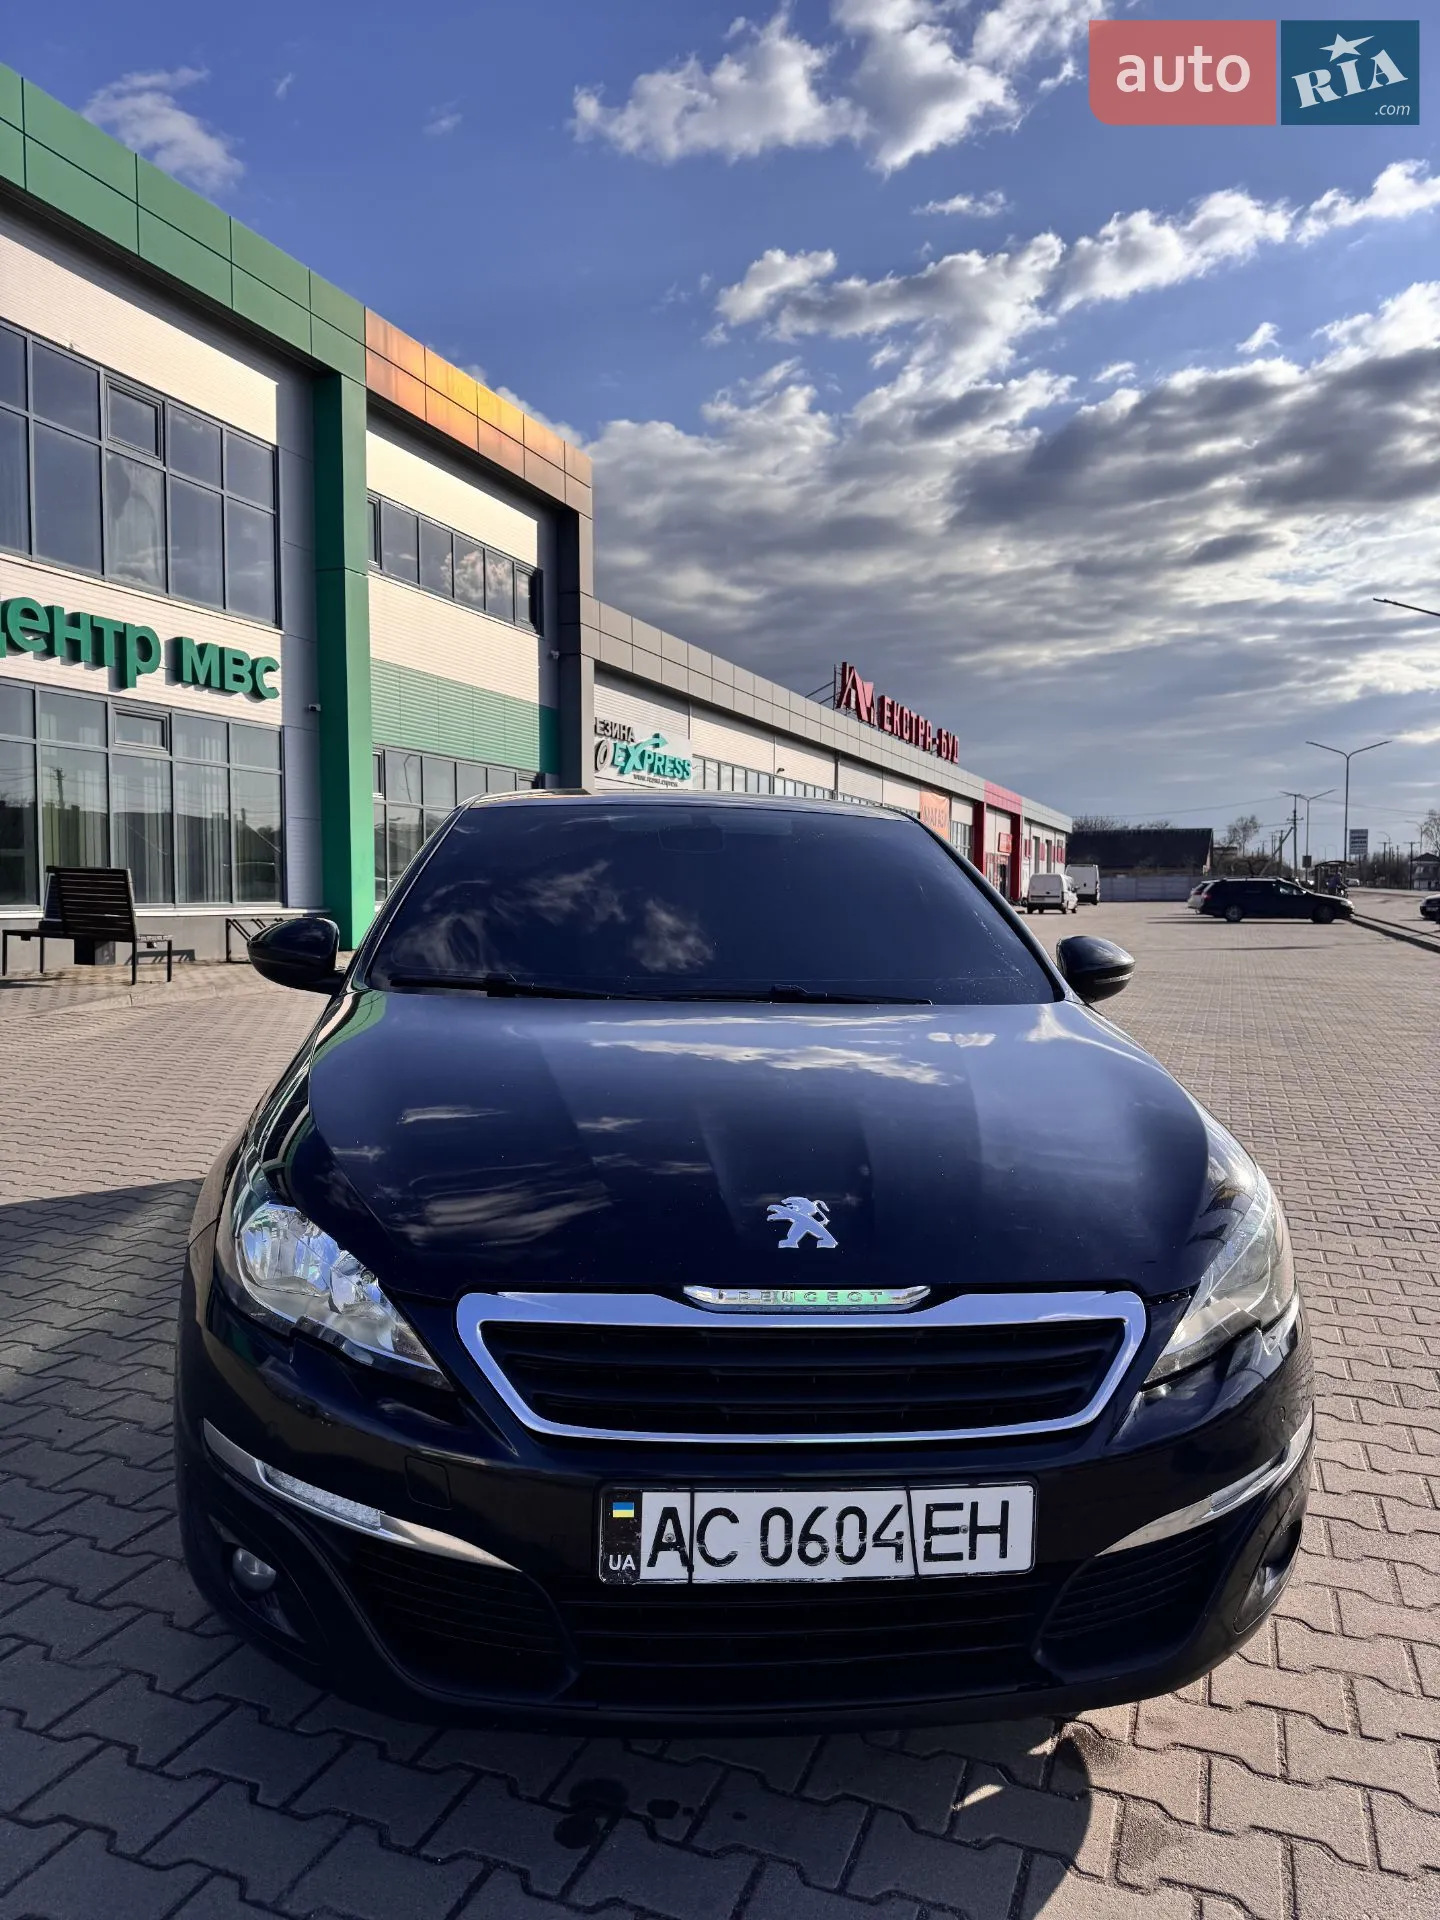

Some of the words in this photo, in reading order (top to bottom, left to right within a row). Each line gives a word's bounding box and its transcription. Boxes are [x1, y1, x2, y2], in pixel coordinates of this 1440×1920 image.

[0, 597, 161, 688] ентр
[178, 636, 280, 699] МВС
[595, 717, 635, 743] ЕЗИНА
[610, 739, 692, 781] EXPRESS
[738, 1290, 883, 1303] PEUGEOT
[760, 1504, 905, 1566] 0604
[922, 1500, 1010, 1563] EH
[608, 1554, 636, 1571] UA
